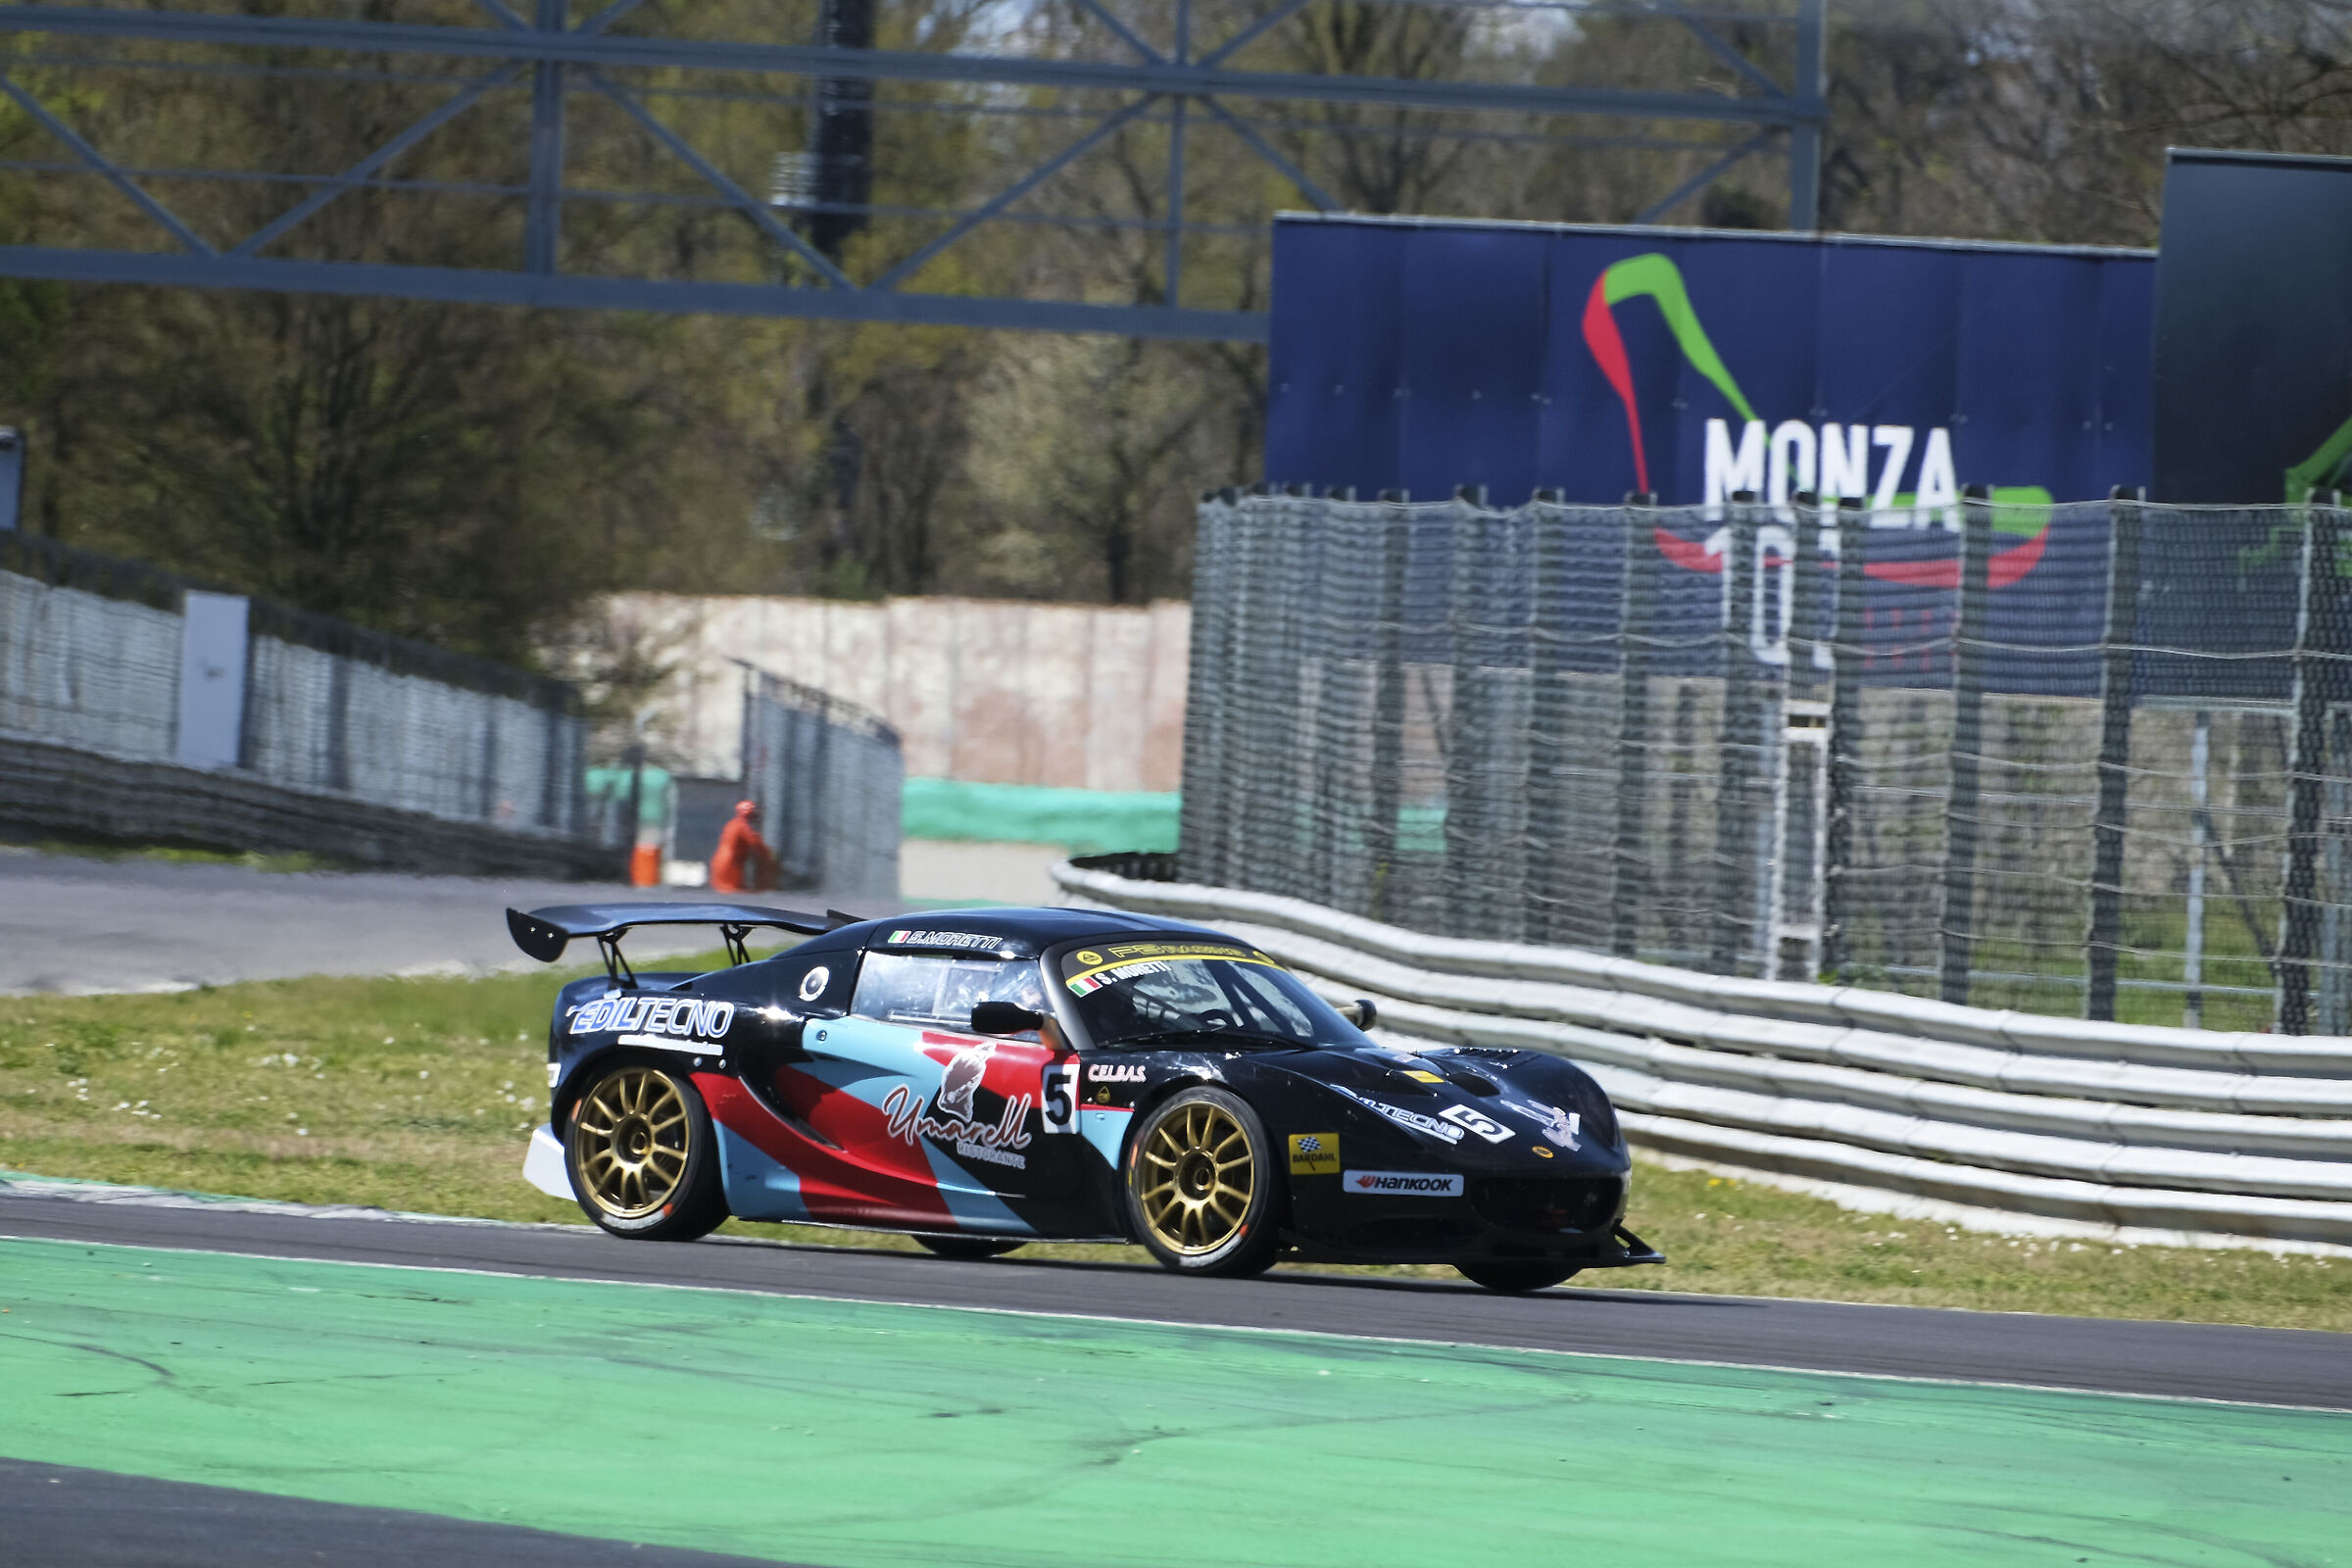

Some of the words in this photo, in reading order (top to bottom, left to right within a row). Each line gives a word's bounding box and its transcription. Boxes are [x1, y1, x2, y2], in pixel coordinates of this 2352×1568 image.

[1704, 418, 1961, 532] MONZA
[1703, 525, 1842, 670] 10
[1115, 960, 1172, 981] MORETTI
[565, 997, 735, 1039] EDILTECNO
[1045, 1073, 1072, 1126] 5
[1452, 1109, 1504, 1137] 5
[1292, 1152, 1338, 1163] BARDAHL
